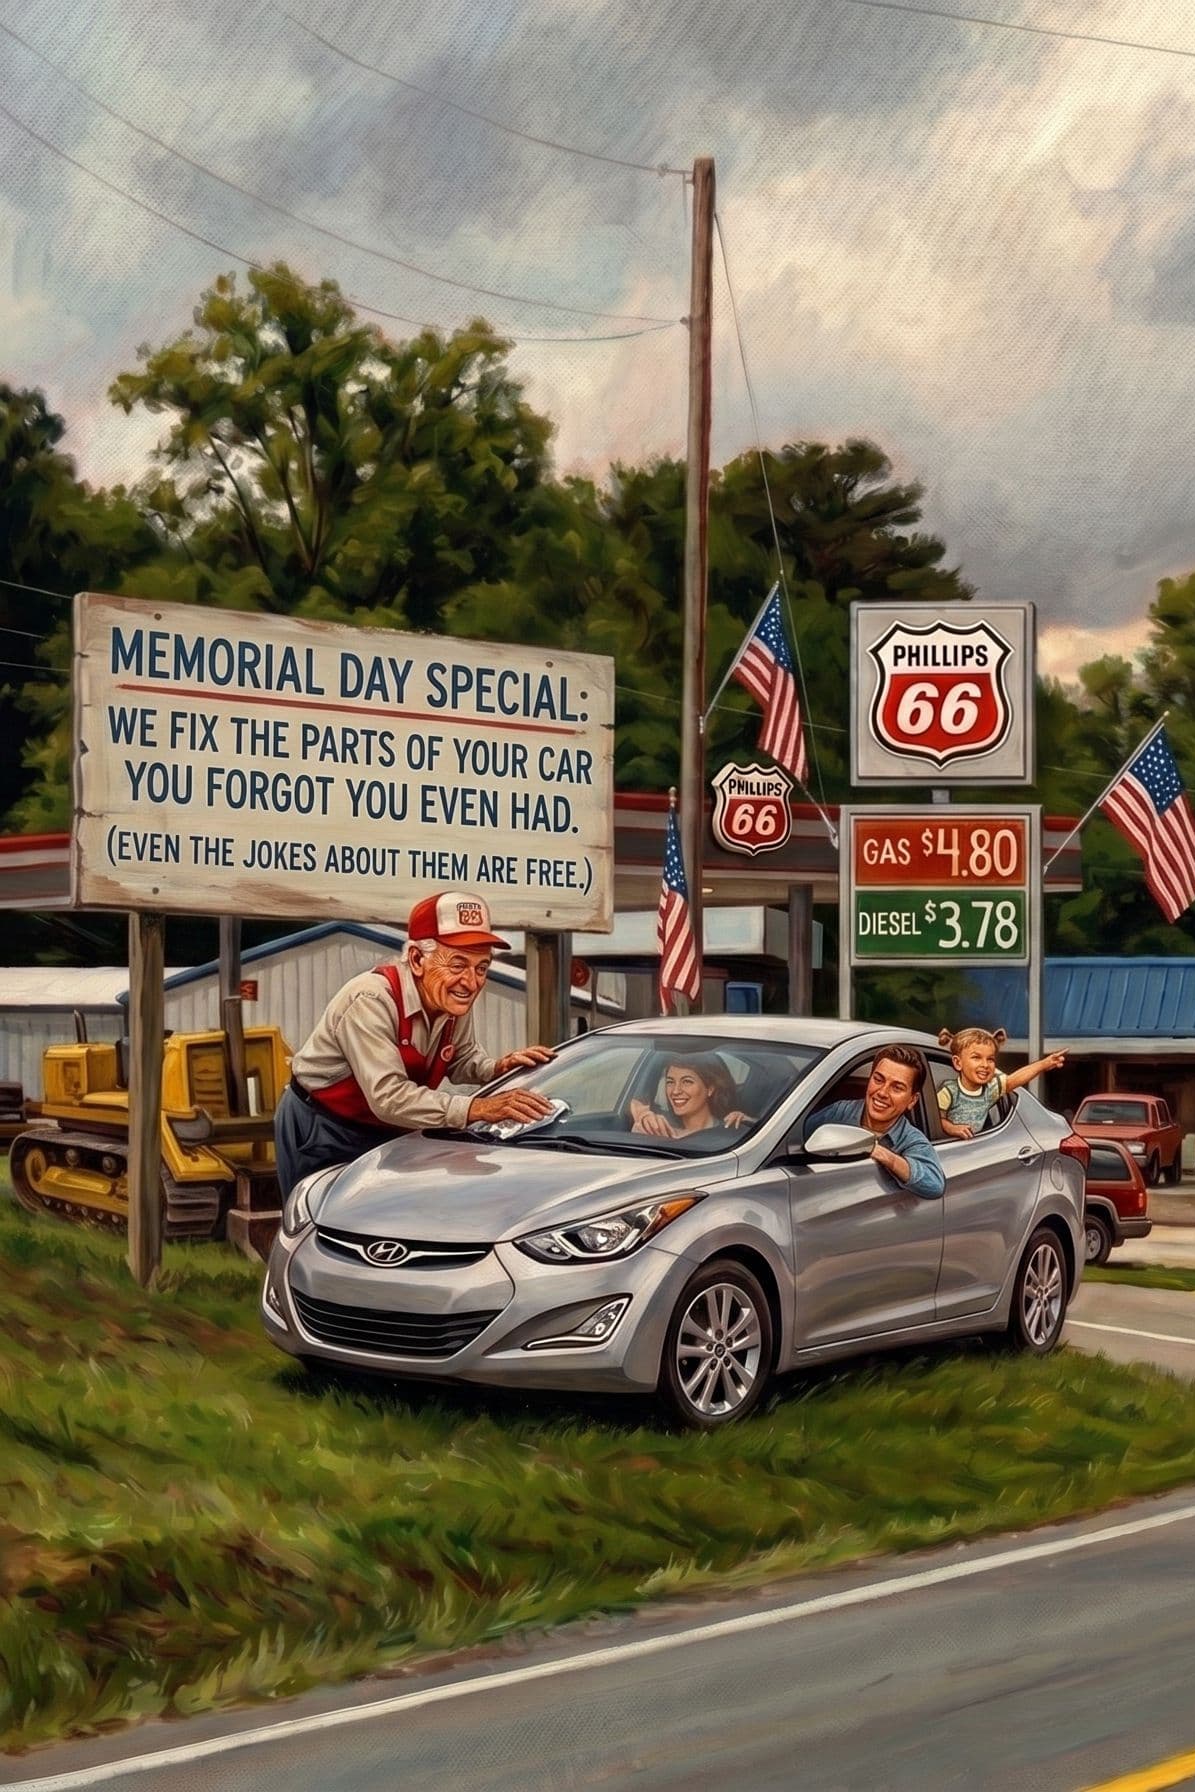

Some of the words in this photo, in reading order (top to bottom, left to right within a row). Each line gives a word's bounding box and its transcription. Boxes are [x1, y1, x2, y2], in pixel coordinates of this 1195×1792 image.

[111, 626, 325, 696] MEMORIAL
[340, 652, 414, 704] DAY
[426, 662, 588, 722] SPECIAL:
[892, 644, 989, 667] PHILLIPS
[896, 682, 982, 735] 66
[108, 705, 158, 748] WE
[170, 711, 219, 752] FIX
[230, 717, 290, 758] THE
[302, 723, 396, 768] PARTS
[406, 733, 443, 771] OF
[453, 738, 529, 779] YOUR
[538, 746, 593, 785] CAR
[124, 760, 193, 805] YOU
[207, 767, 335, 816] FORGOT
[345, 779, 408, 821] YOU
[421, 784, 498, 828] EVEN
[511, 792, 579, 834] HAD.
[731, 803, 778, 836] 66
[107, 824, 180, 867] (EVEN
[189, 835, 235, 866] THE
[243, 839, 317, 872] JOKES
[324, 844, 401, 877] ABOUT
[408, 850, 468, 882] THEM
[476, 855, 518, 885] ARE
[526, 856, 593, 896] FREE.)
[863, 838, 911, 866] GAS
[921, 828, 1019, 878] $4.80
[858, 911, 923, 937] DIESEL
[924, 900, 1019, 949] $3.78
